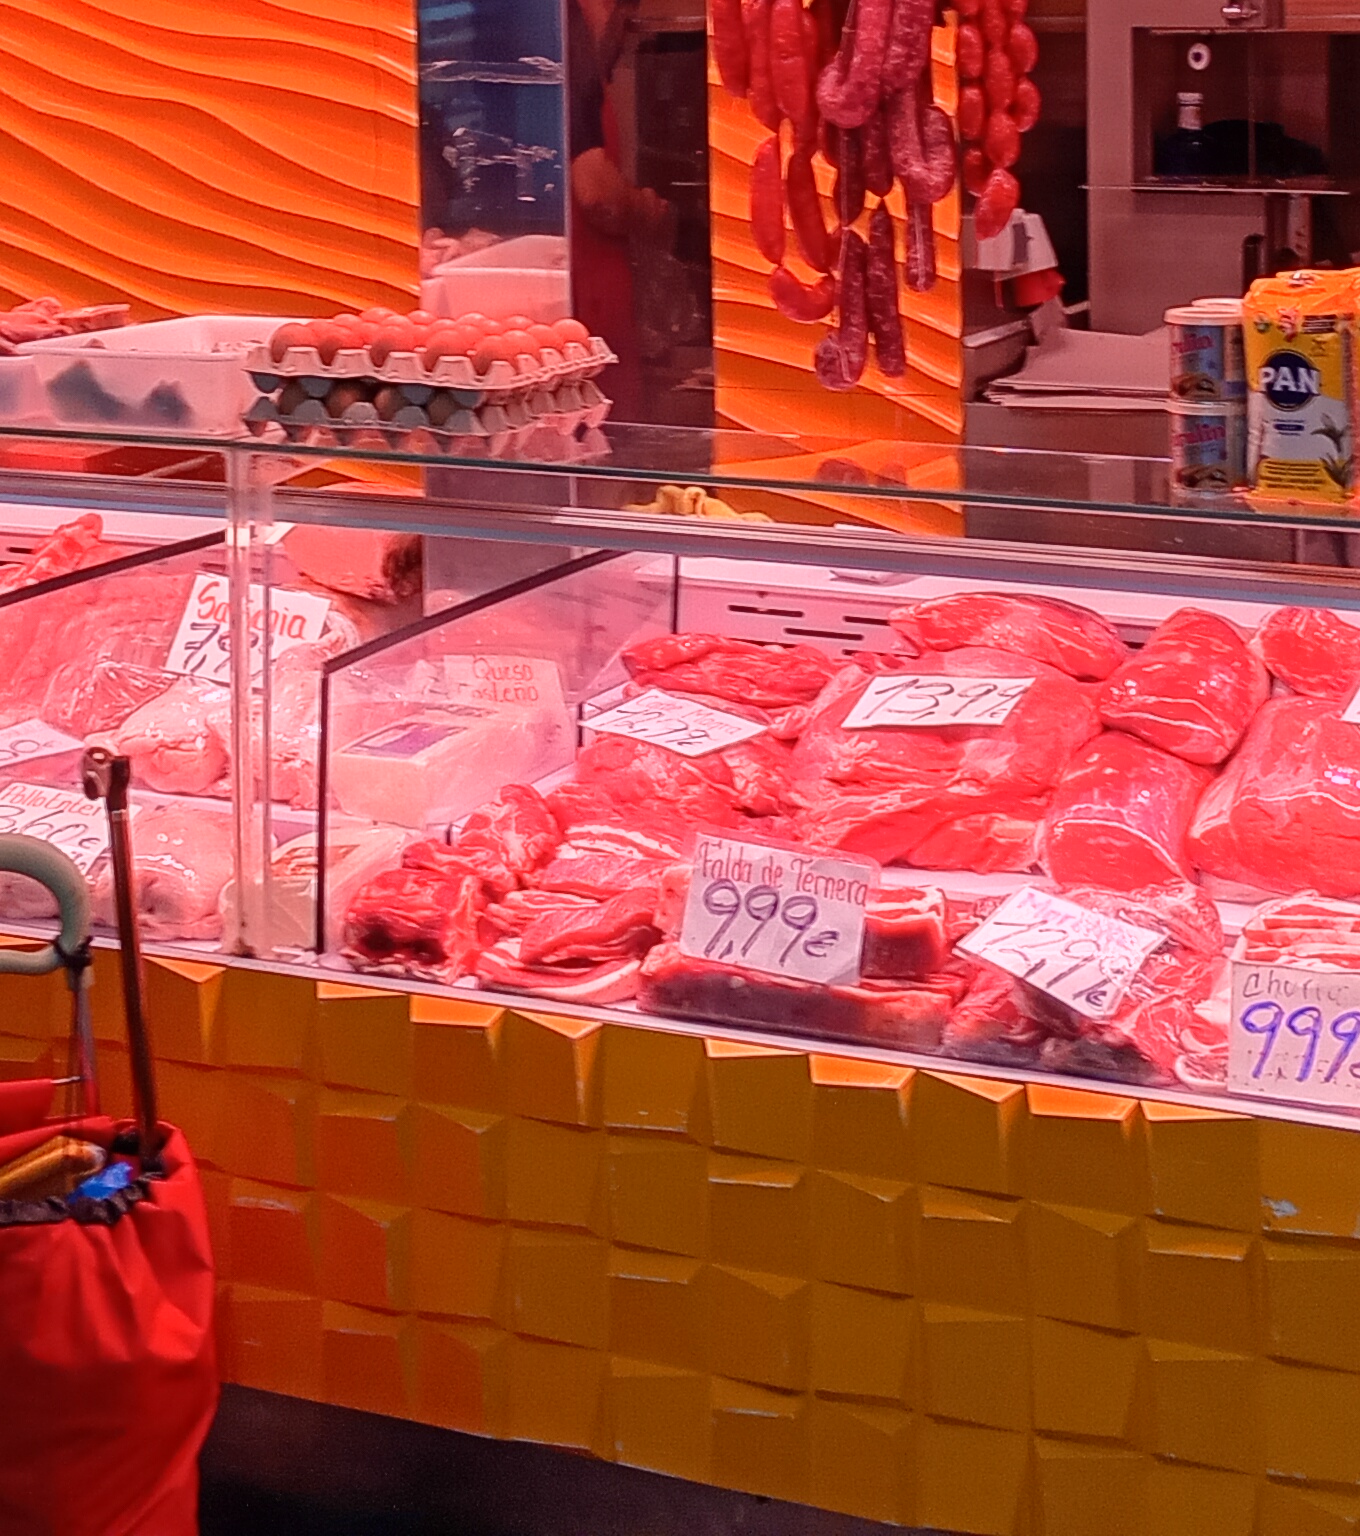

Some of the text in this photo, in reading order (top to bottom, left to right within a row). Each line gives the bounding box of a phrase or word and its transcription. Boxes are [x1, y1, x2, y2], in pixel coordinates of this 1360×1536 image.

[1258, 365, 1321, 396] PAN
[197, 580, 308, 640] Saonia
[473, 656, 534, 682] Queso
[0, 784, 103, 817] Pollo Enter
[698, 839, 869, 907] Falda de Ternera
[702, 878, 840, 967] 9,99€
